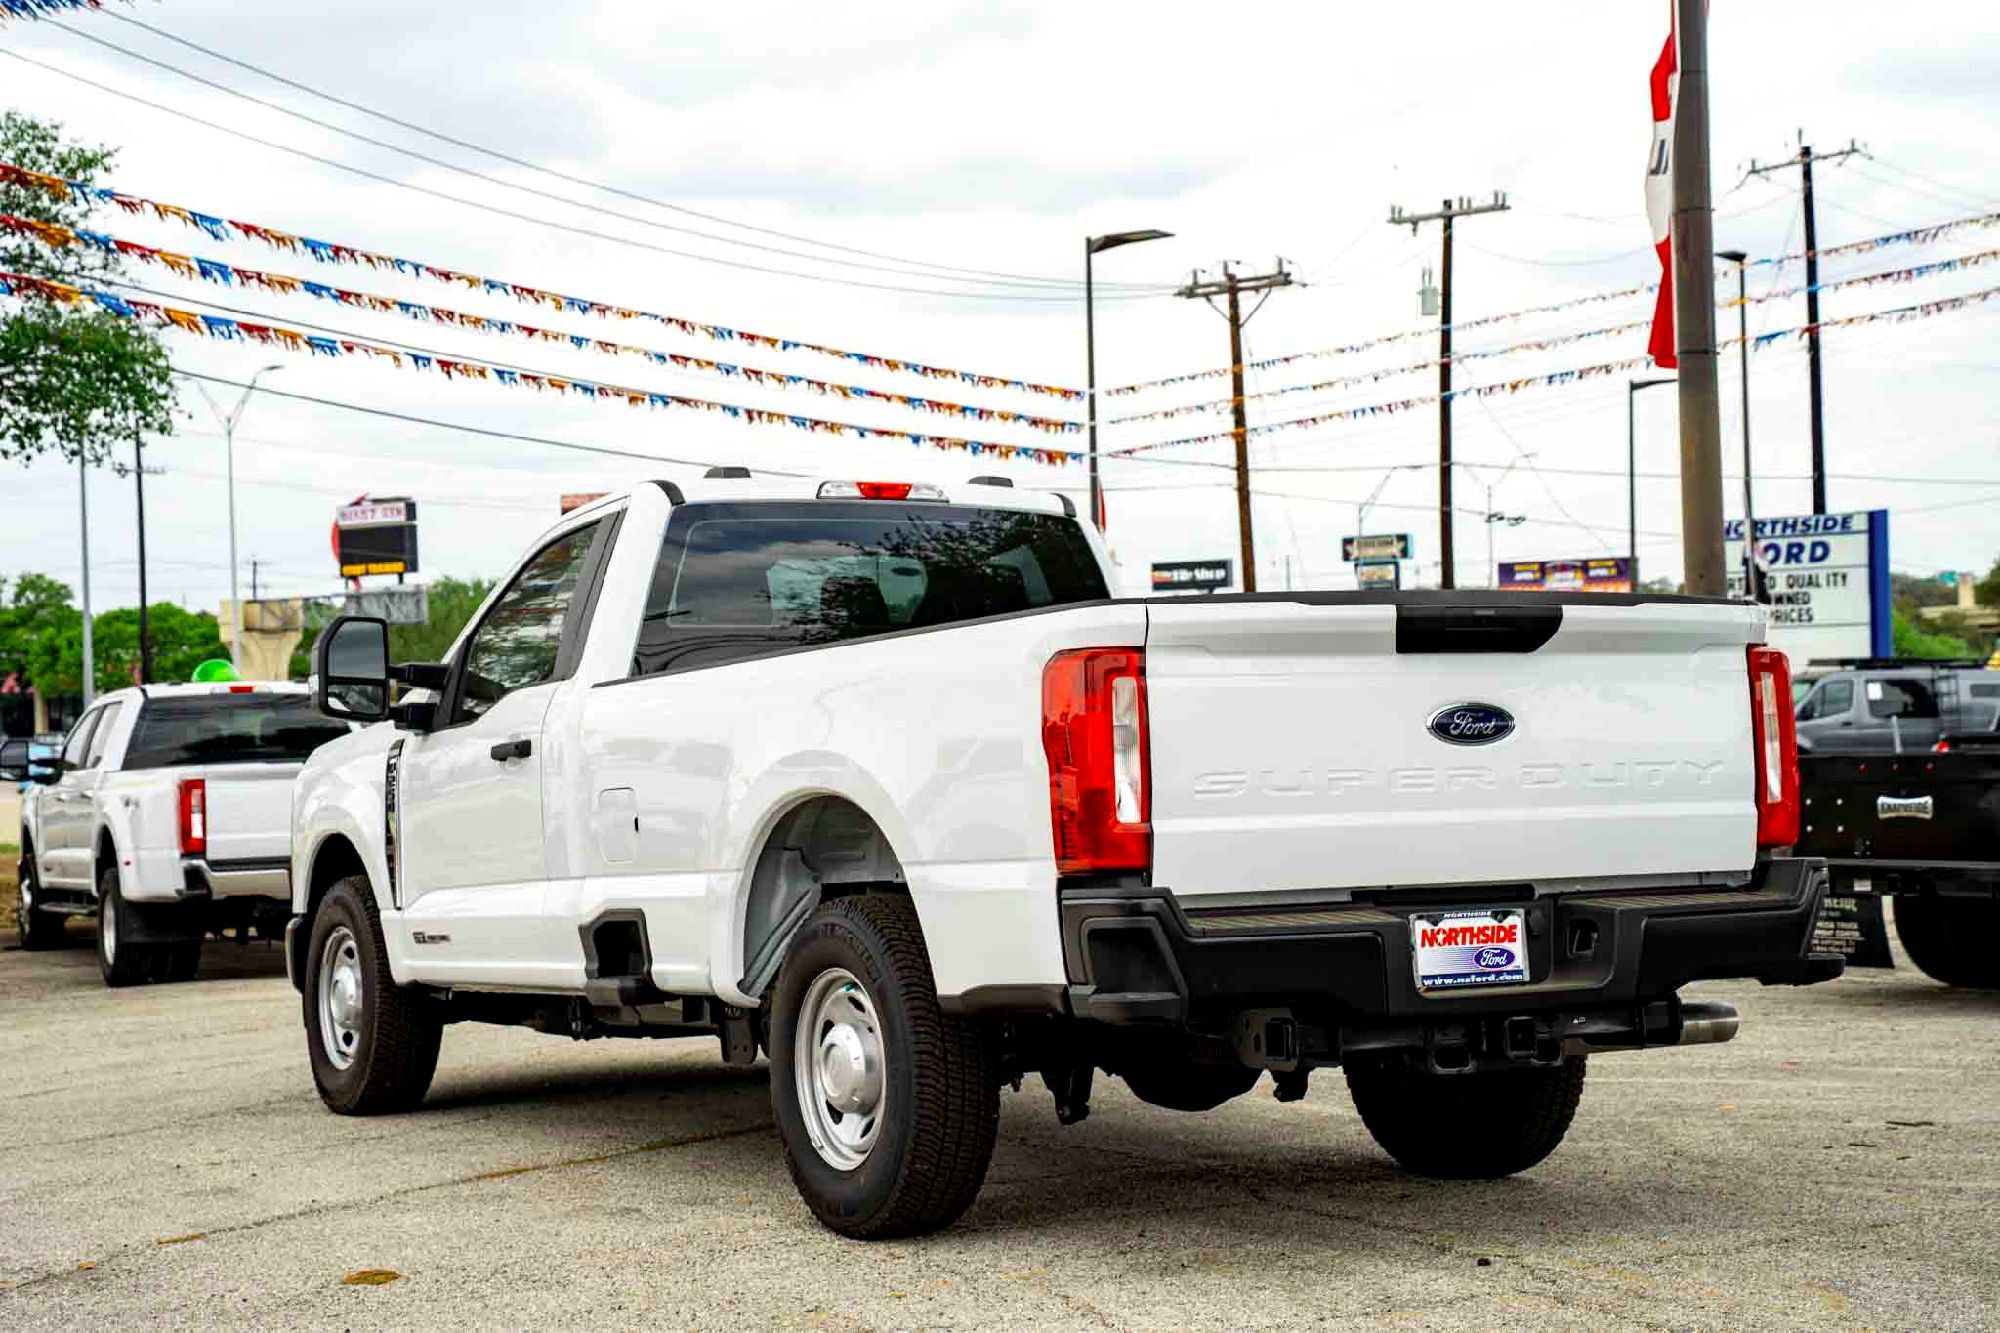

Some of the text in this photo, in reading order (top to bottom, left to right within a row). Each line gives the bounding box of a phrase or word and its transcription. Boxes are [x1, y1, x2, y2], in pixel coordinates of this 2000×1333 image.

[1763, 541, 1830, 565] ORD
[1786, 572, 1847, 589] QUALITY
[1774, 592, 1811, 605] WNED
[1449, 711, 1496, 735] Ford
[1194, 759, 1725, 798] SUPER DUTY
[1422, 925, 1517, 947] NORTHSIDE
[1481, 948, 1507, 966] Ford
